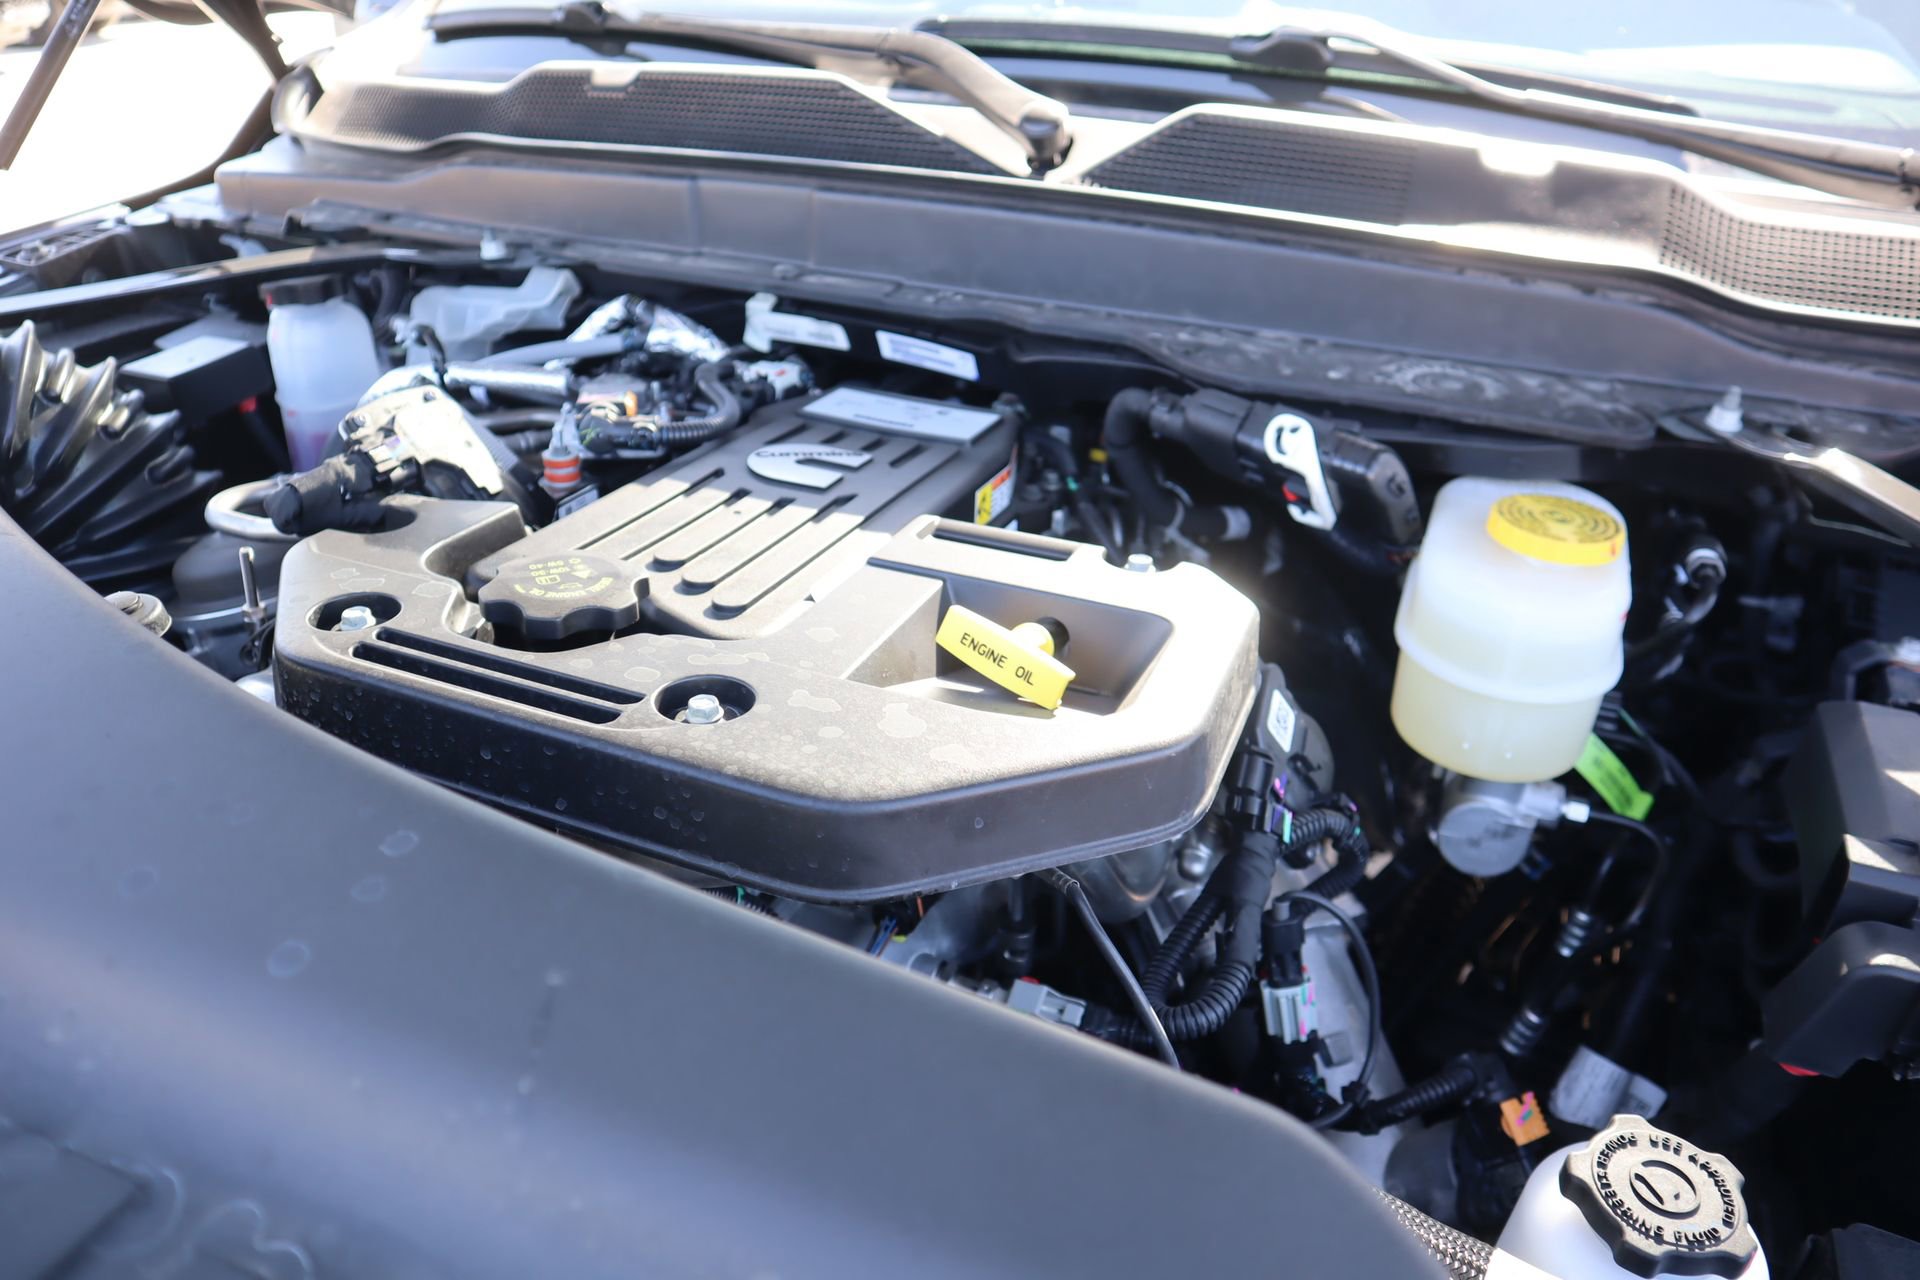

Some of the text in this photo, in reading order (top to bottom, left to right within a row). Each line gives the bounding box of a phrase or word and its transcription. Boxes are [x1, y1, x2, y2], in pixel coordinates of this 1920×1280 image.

[960, 632, 1034, 686] ENGINE OIL
[1597, 1133, 1722, 1246] POWER STEERING FLUID
[1649, 1133, 1736, 1229] USE APPROVED
